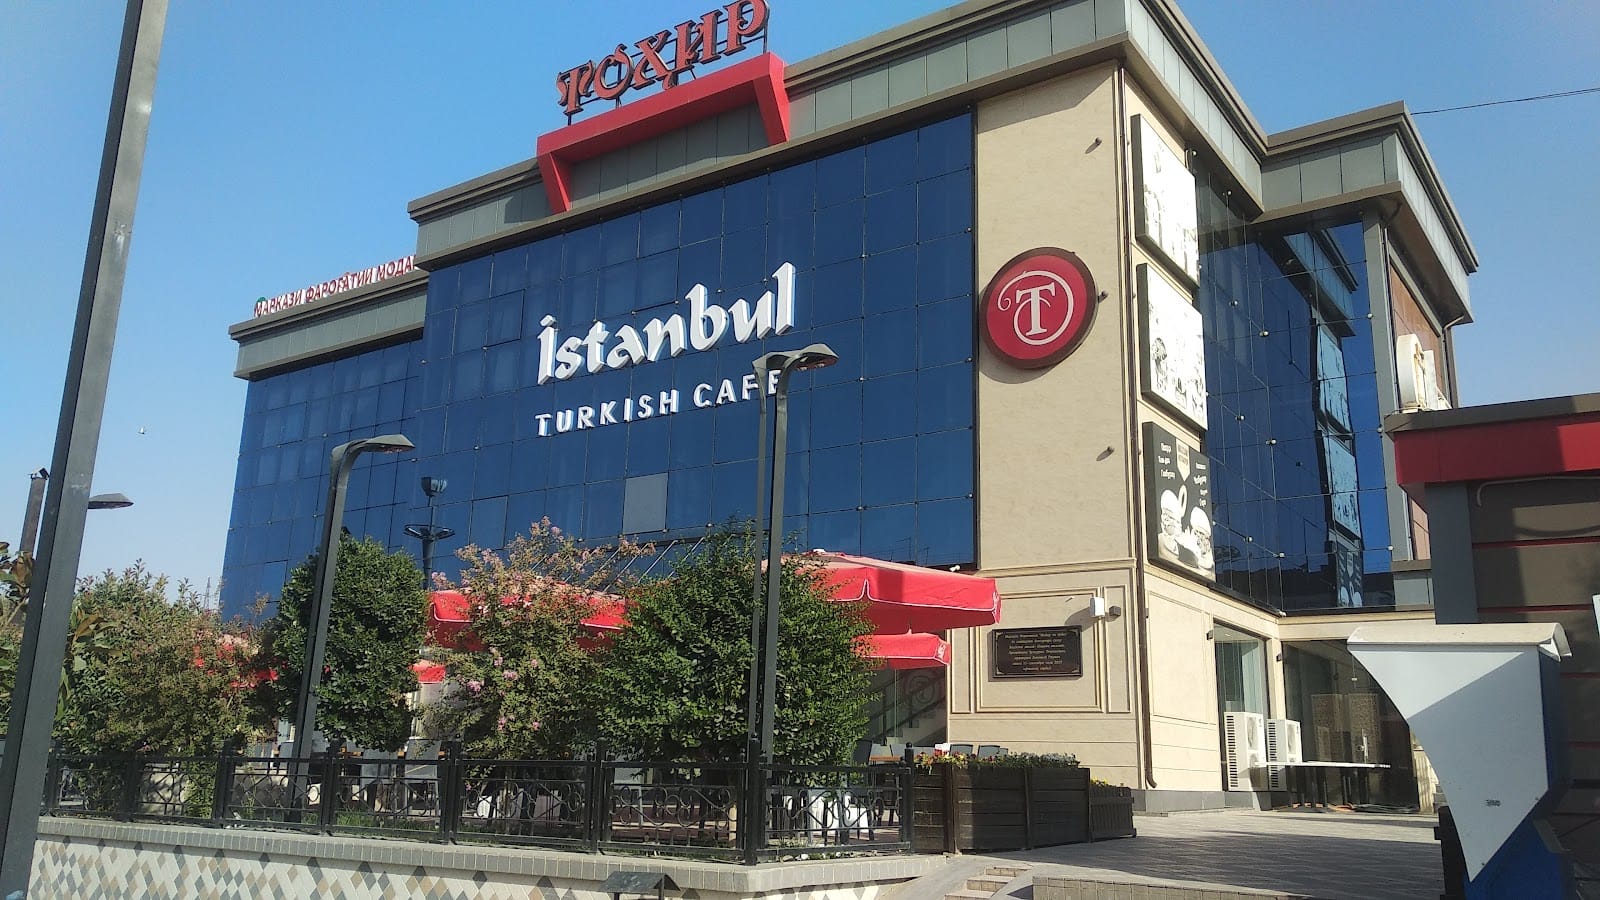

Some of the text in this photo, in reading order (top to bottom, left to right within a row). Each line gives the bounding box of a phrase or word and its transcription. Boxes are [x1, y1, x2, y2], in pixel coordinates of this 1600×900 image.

[253, 289, 304, 318] МАРКАЗИ
[535, 369, 782, 437] TURKISH CAFE
